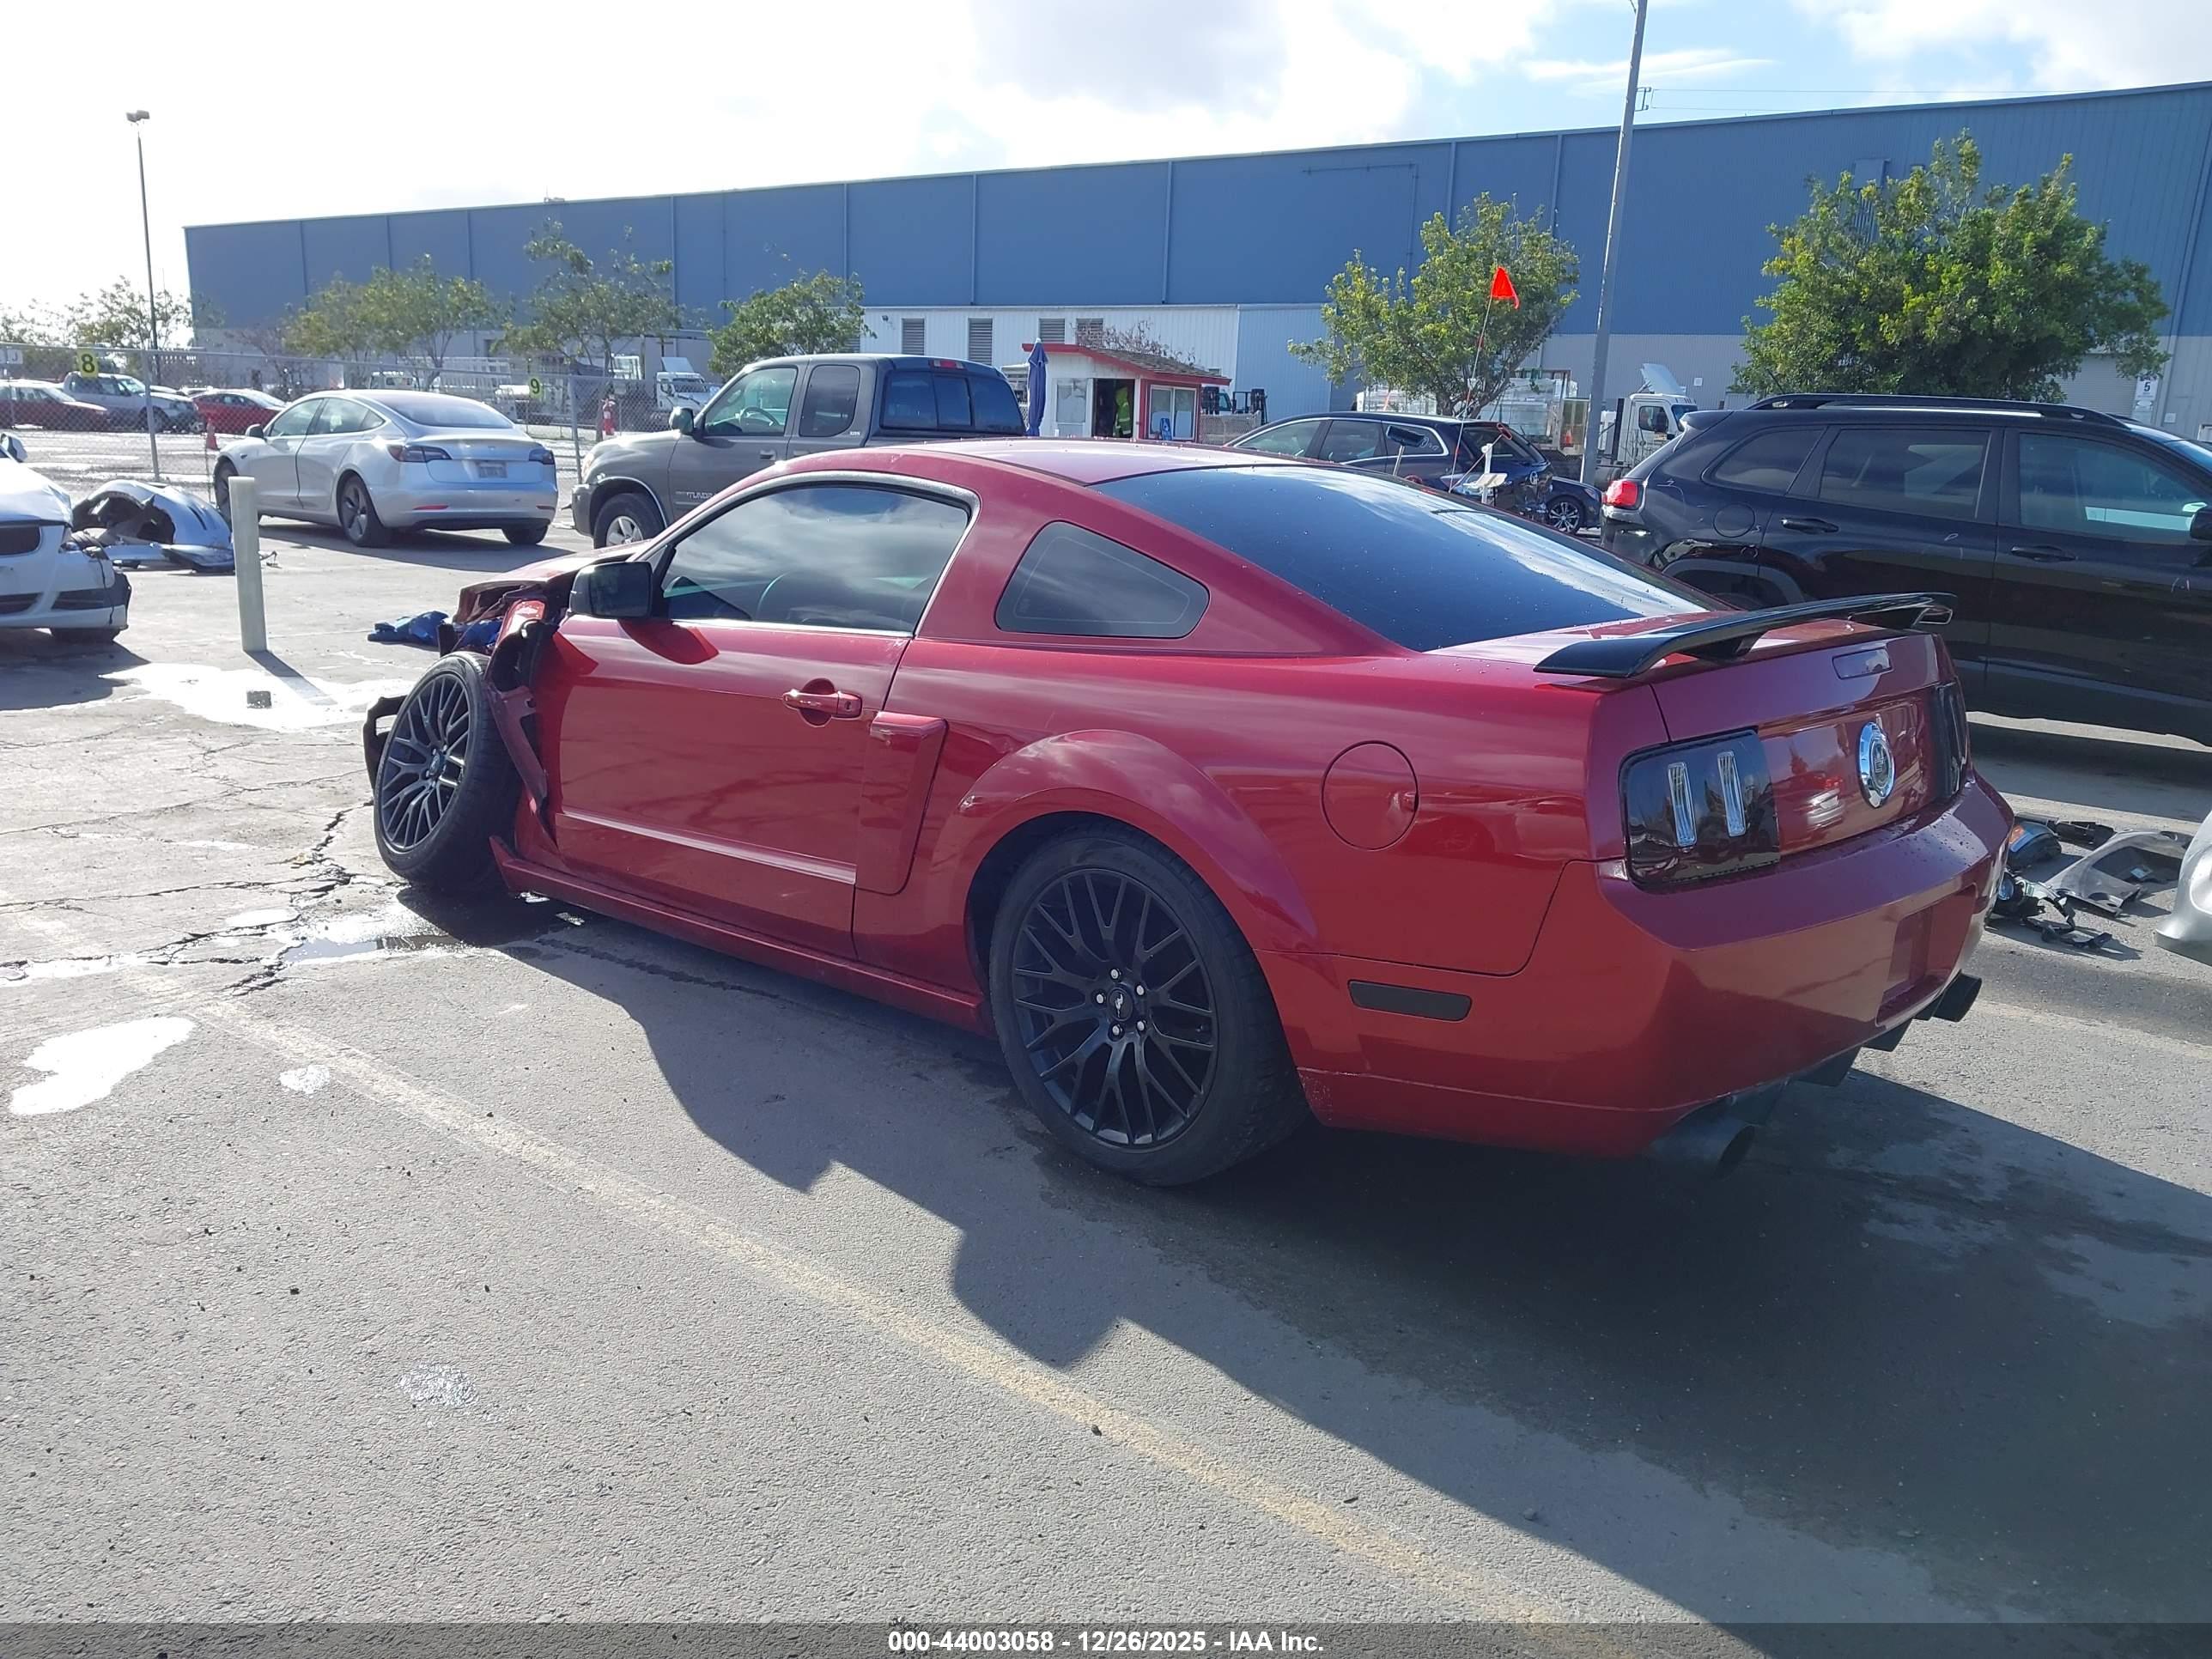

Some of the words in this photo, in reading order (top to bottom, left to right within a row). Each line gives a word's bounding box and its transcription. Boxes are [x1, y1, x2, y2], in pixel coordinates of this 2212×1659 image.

[81, 354, 95, 373] 8
[530, 378, 540, 394] 9
[2143, 381, 2151, 392] 5
